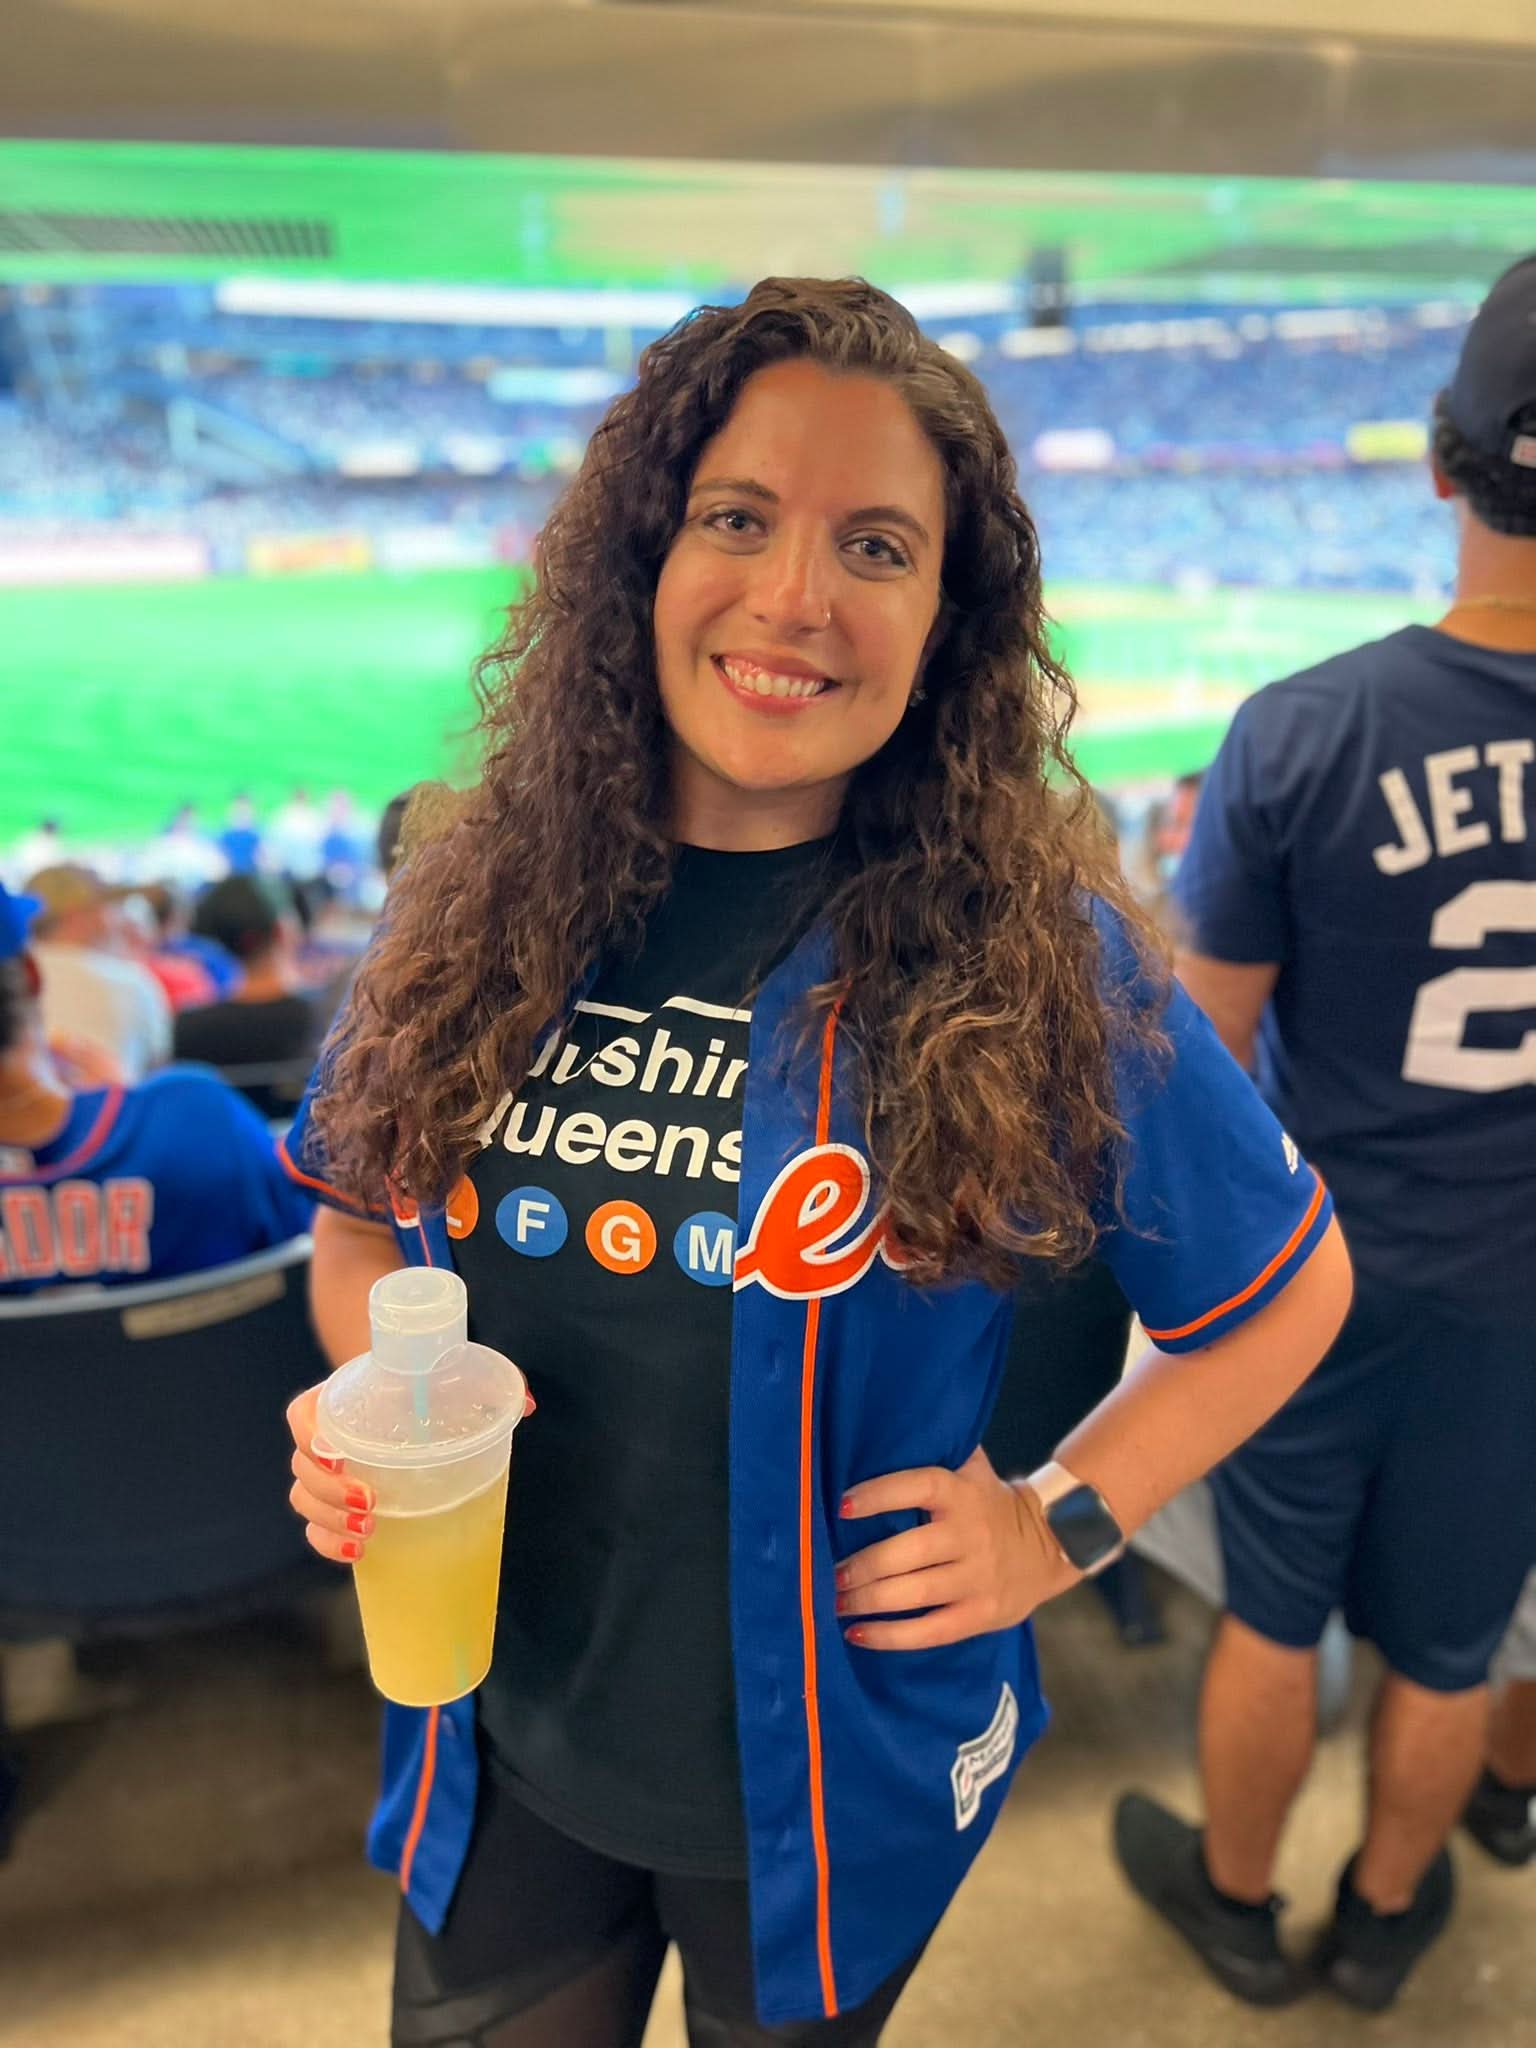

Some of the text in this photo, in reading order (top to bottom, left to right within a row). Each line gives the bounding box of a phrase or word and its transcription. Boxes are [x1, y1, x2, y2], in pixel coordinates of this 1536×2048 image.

[1372, 739, 1534, 877] JET
[1402, 880, 1536, 1093] 2
[0, 1177, 153, 1282] DOR
[516, 1200, 734, 1275] F G M
